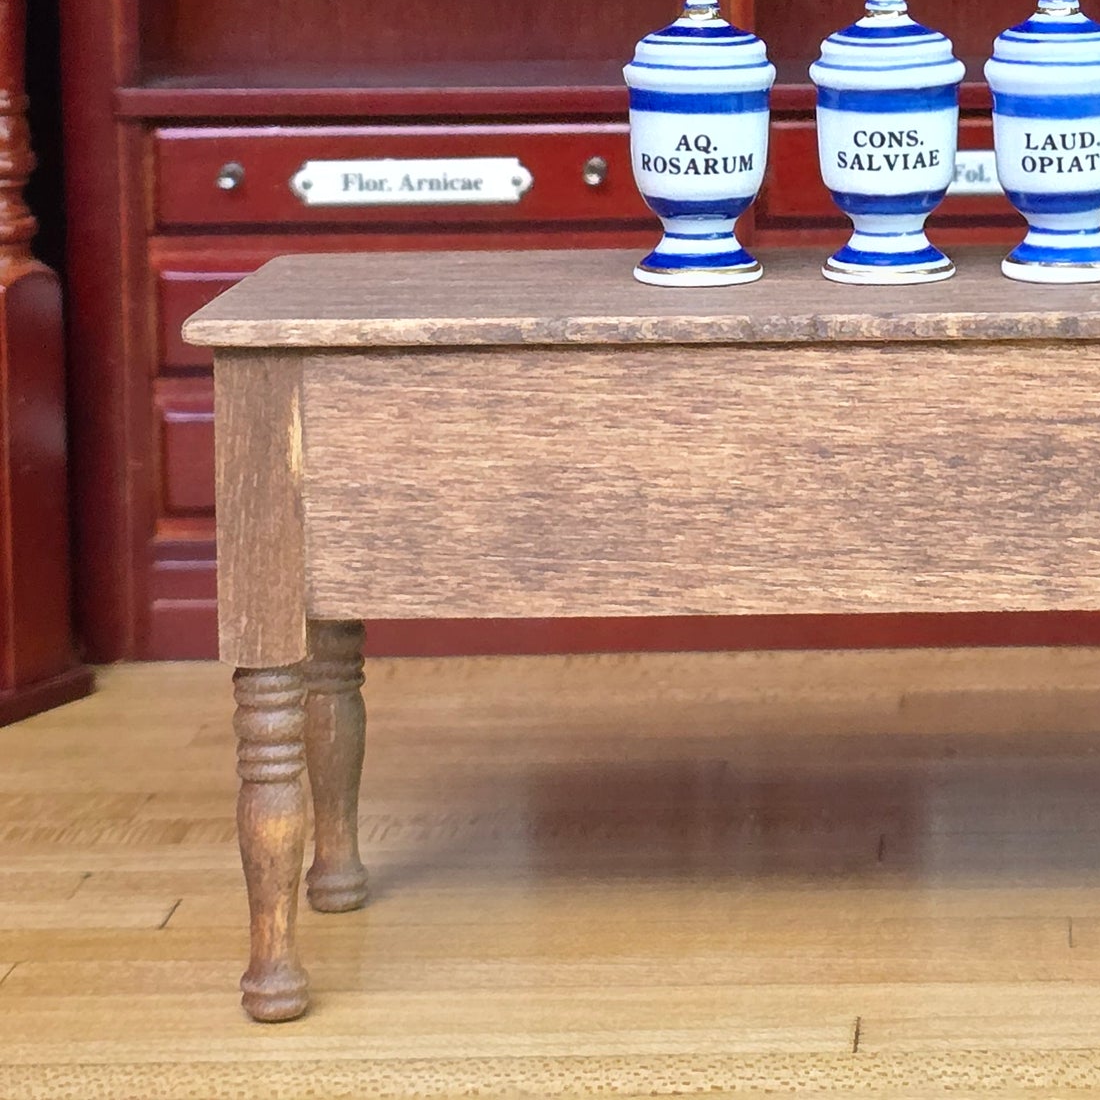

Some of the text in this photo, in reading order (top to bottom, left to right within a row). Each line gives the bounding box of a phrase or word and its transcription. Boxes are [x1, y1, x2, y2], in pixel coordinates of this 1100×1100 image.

[675, 134, 718, 154] AQ.
[853, 129, 924, 149] CONS.
[1024, 131, 1100, 151] LAUD.
[641, 152, 754, 175] ROSARUM
[836, 149, 940, 171] SALVIAE
[340, 171, 483, 192] Flor. Arnicae
[952, 163, 991, 183] Fol.
